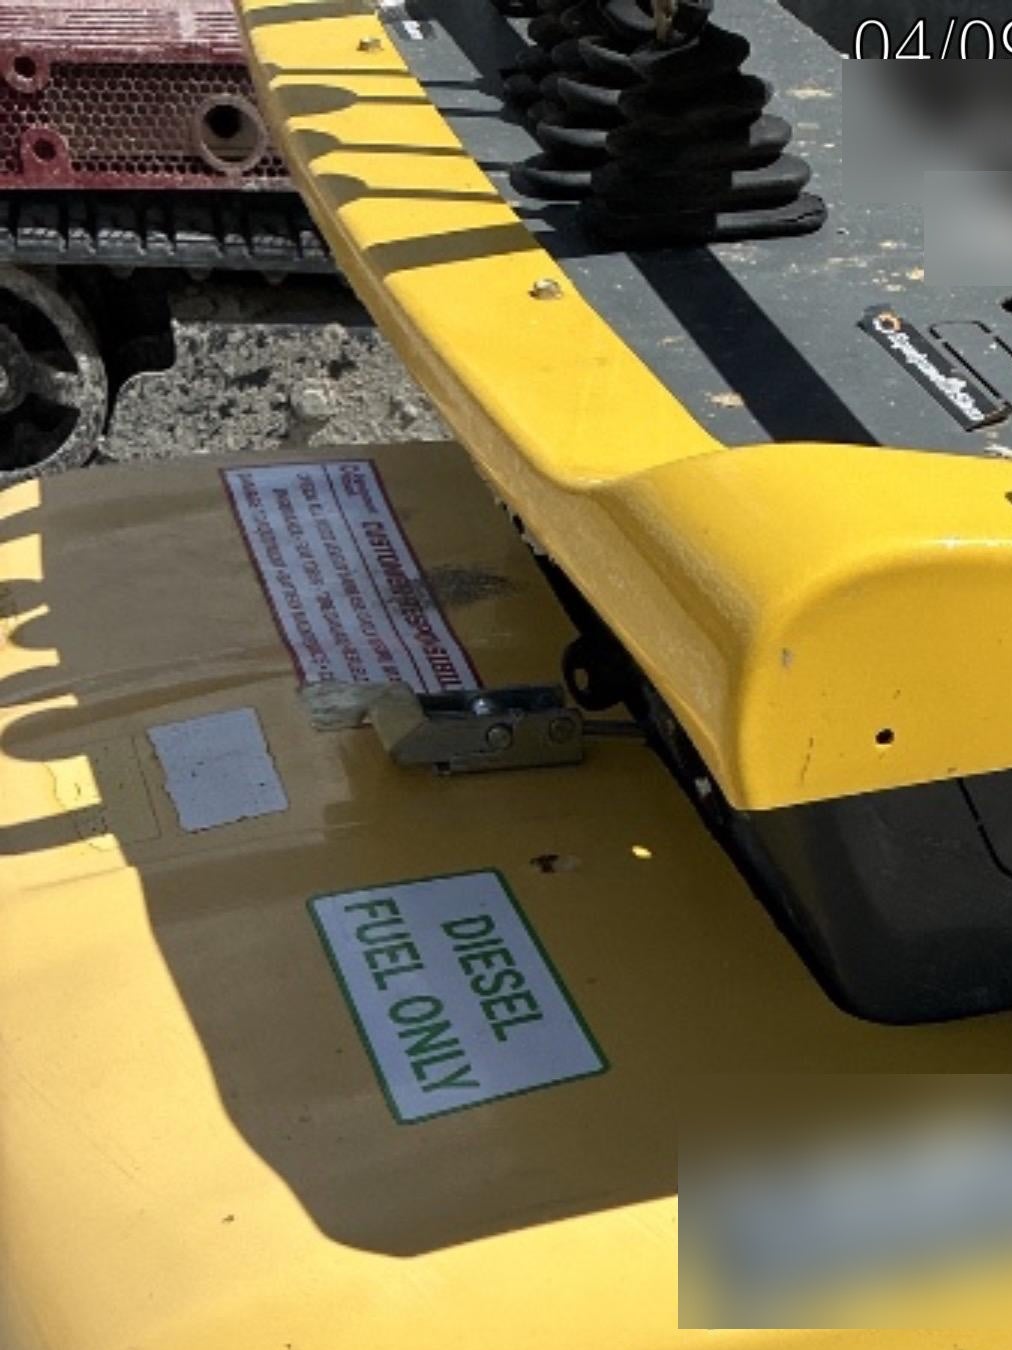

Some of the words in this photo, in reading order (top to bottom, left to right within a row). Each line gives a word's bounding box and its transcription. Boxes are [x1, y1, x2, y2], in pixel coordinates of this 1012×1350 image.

[344, 897, 424, 991] FUEL
[388, 994, 480, 1093] ONLY
[440, 914, 544, 1043] DIESEL
